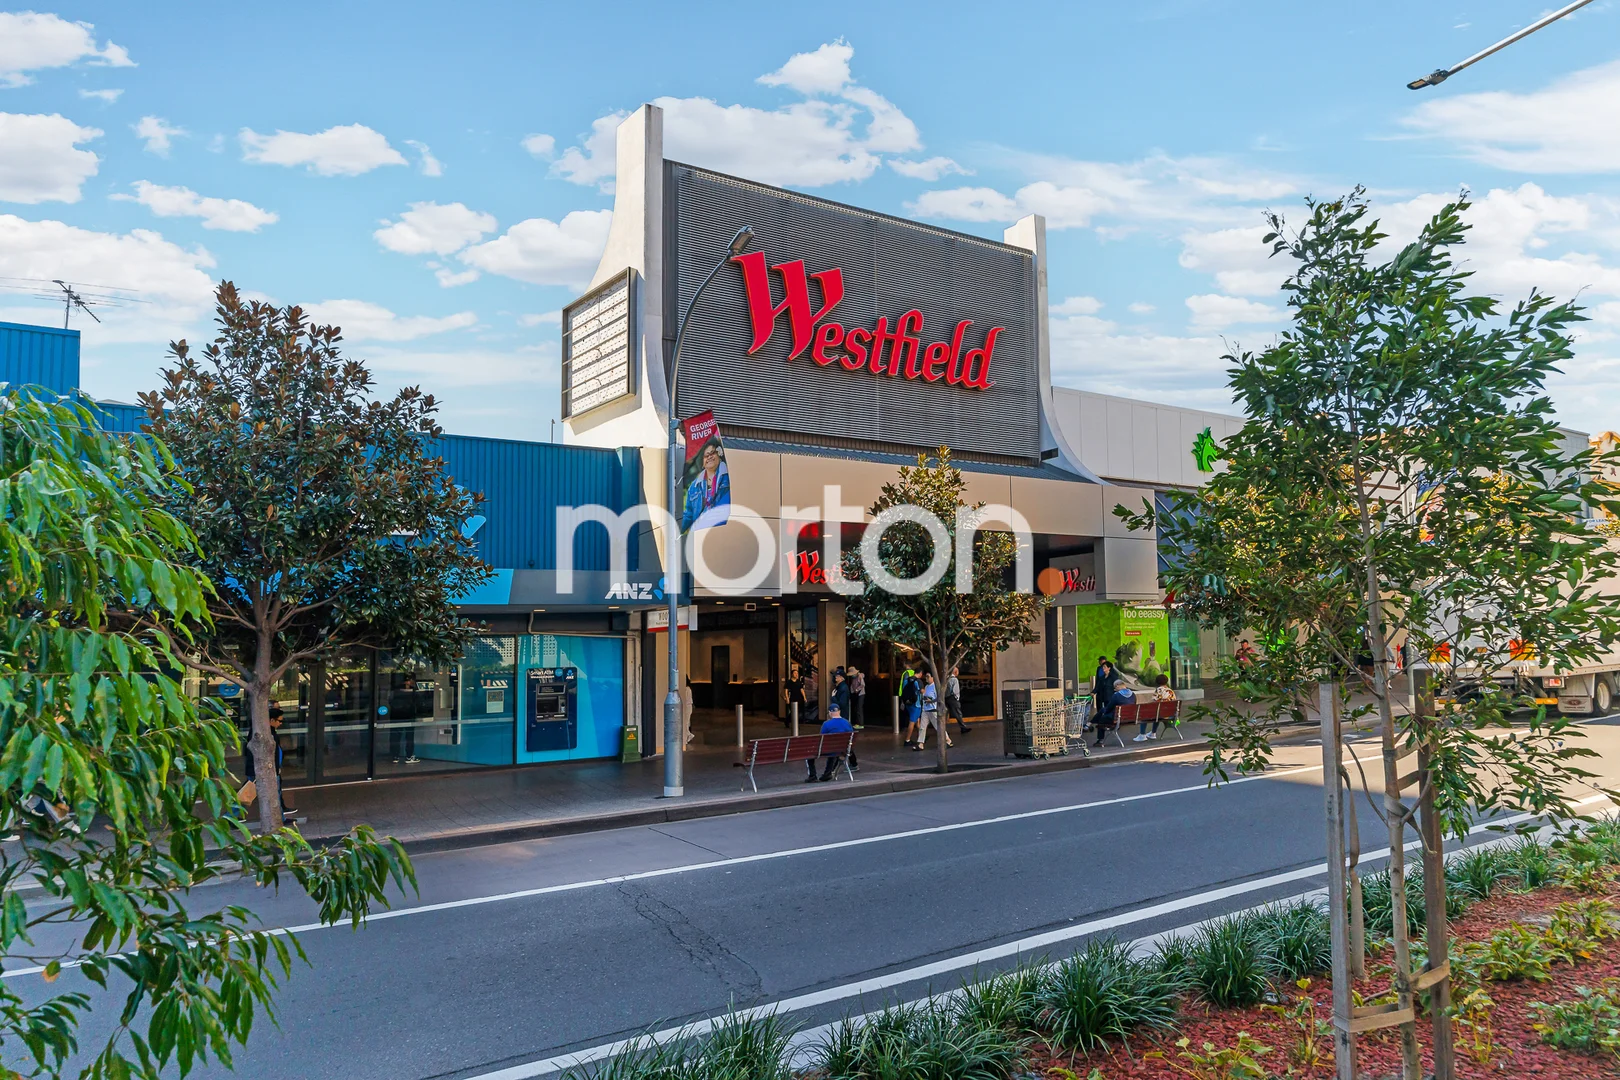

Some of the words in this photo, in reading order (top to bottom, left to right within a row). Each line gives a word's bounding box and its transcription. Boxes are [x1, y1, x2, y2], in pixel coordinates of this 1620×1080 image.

[730, 251, 1005, 390] Westfield
[605, 583, 653, 600] ANZ
[1122, 608, 1137, 619] Too
[1138, 610, 1166, 620] eeassy
